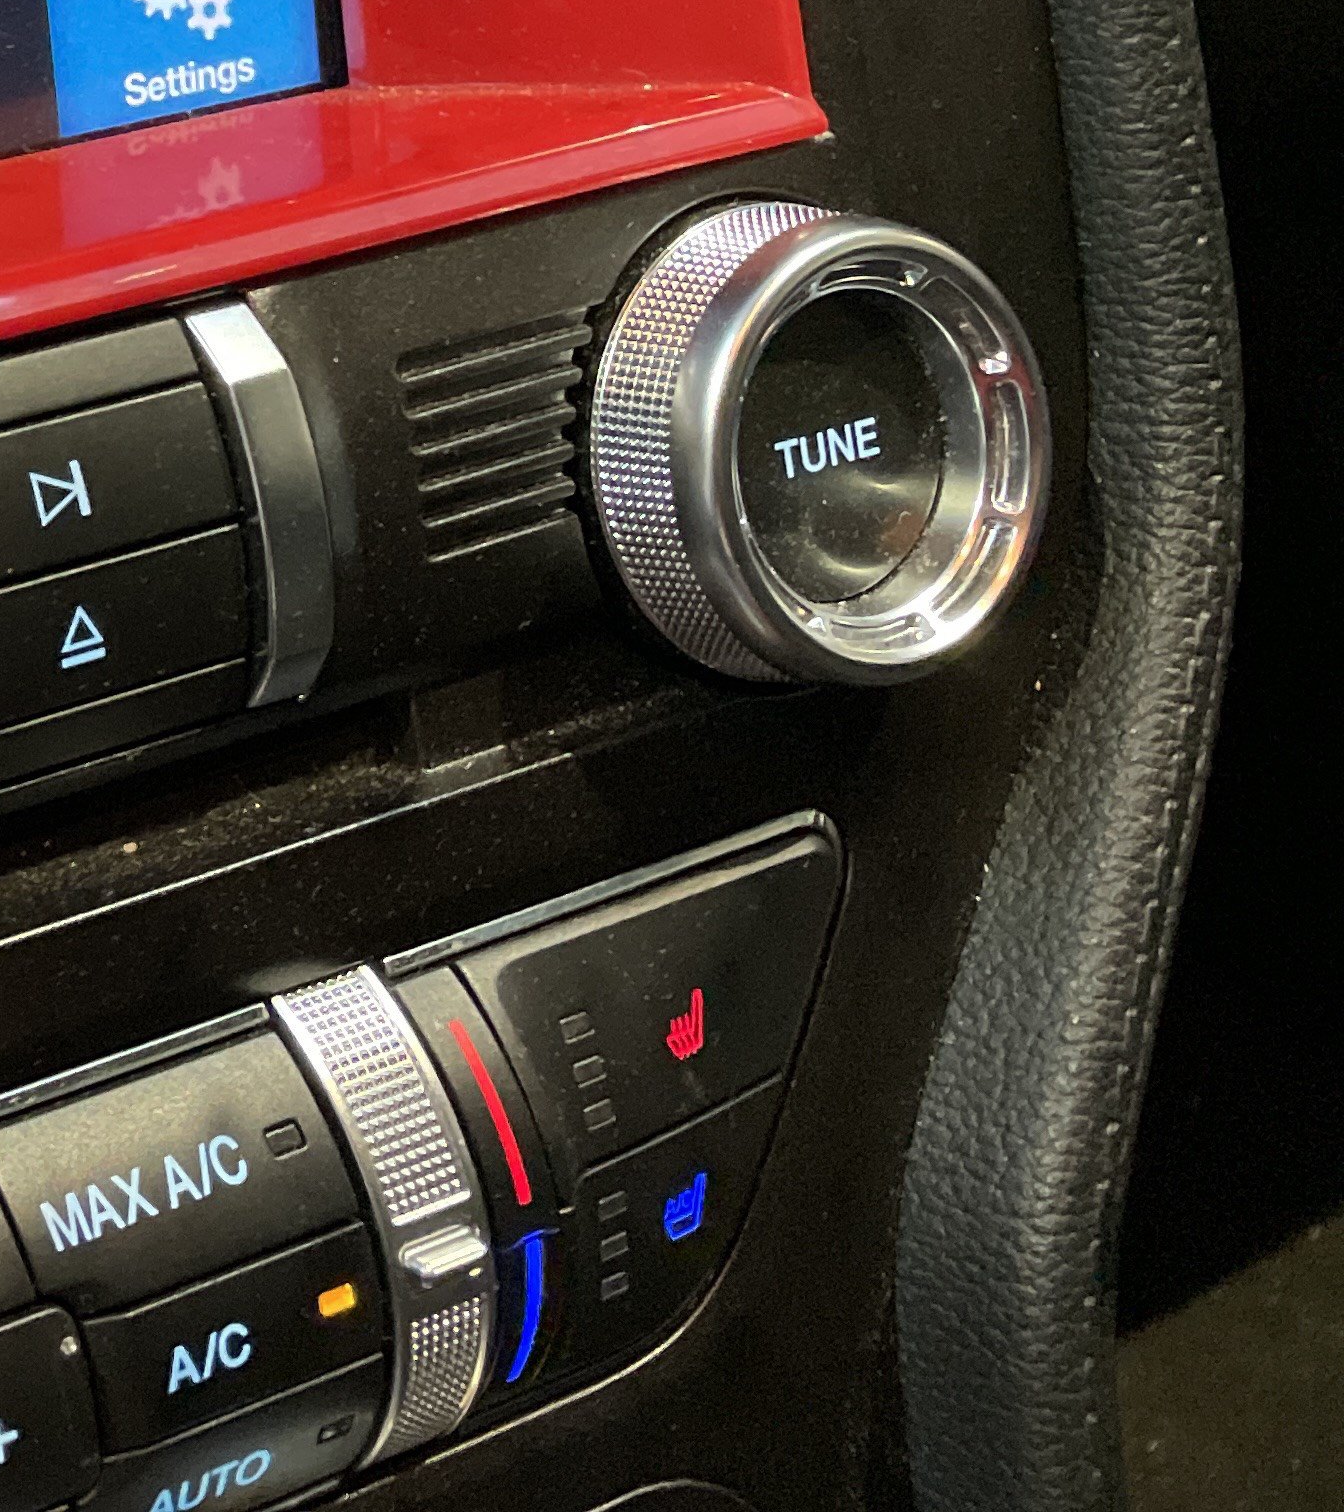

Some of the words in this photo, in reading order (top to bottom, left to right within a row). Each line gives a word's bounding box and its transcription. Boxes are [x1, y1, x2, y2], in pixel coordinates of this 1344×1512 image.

[123, 56, 256, 108] Settings
[775, 417, 880, 478] TUNE
[40, 1167, 159, 1251] MAX
[164, 1135, 247, 1209] A/C
[169, 1323, 250, 1393] A/C
[150, 1449, 272, 1512] AUTO
